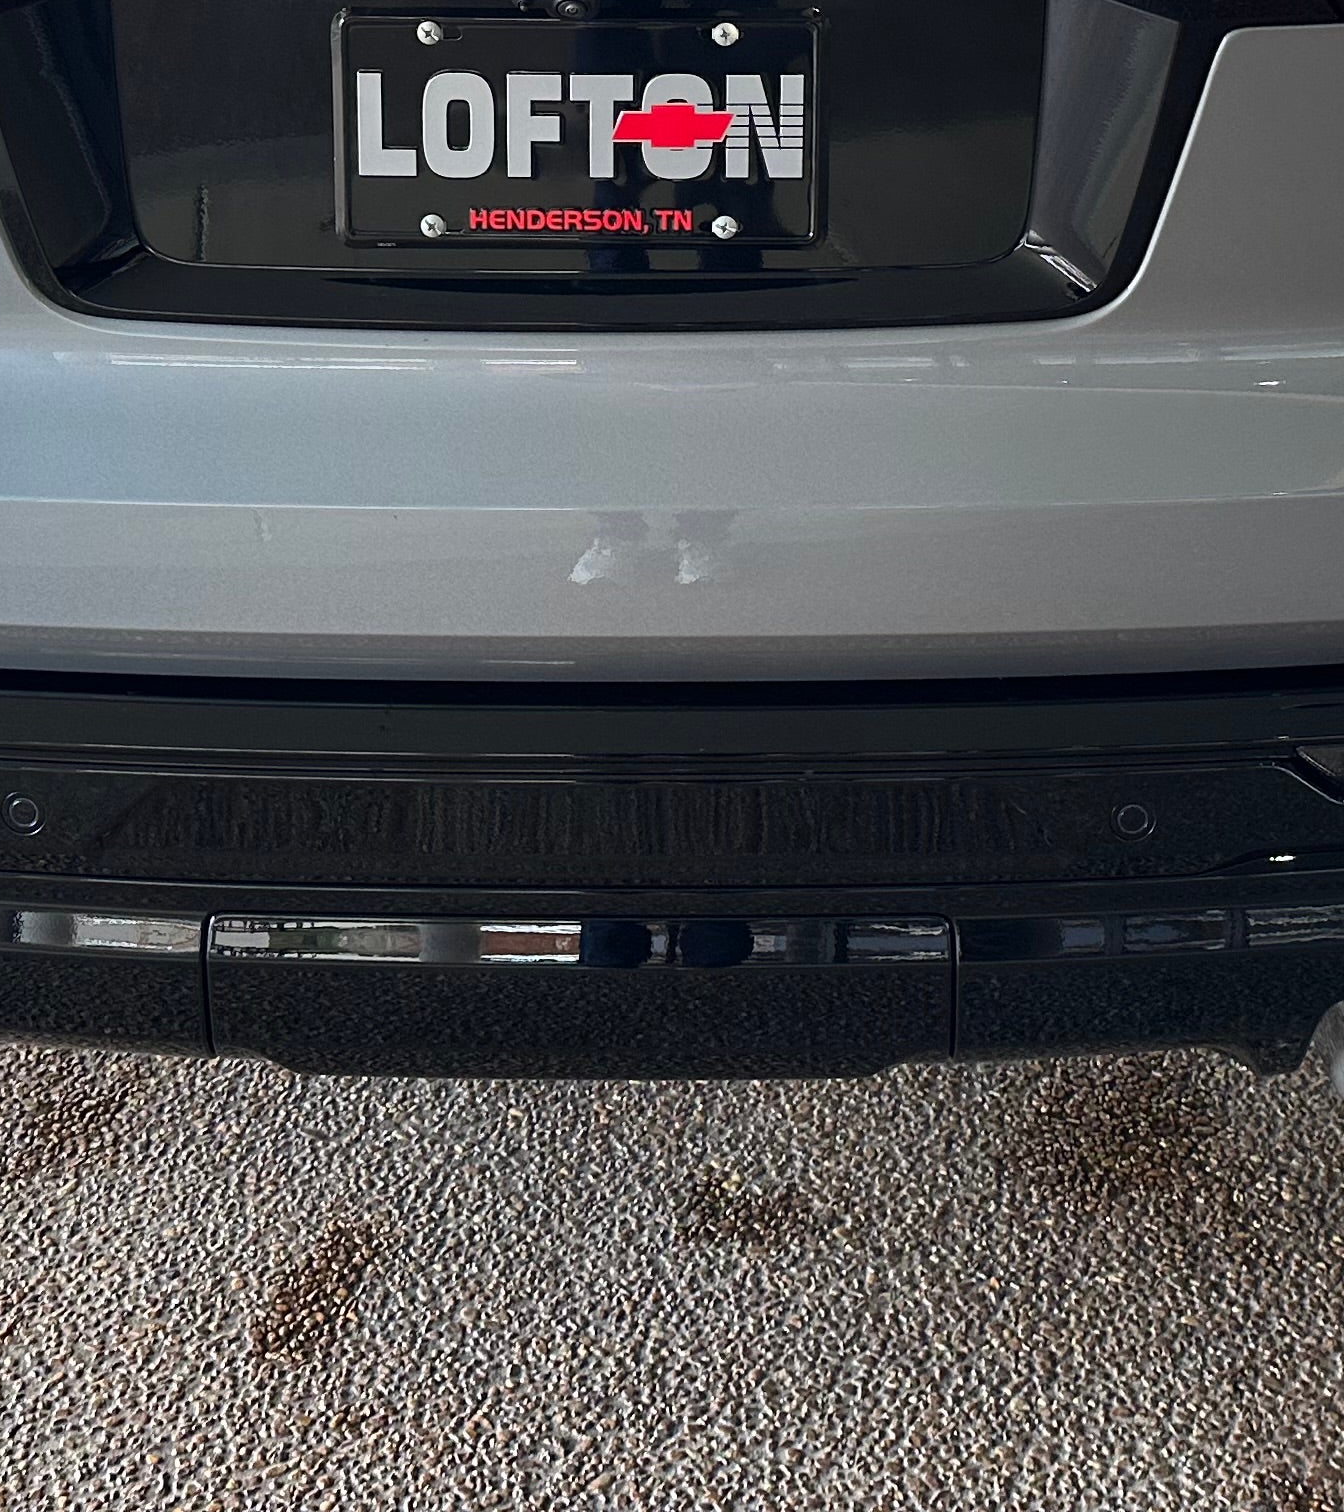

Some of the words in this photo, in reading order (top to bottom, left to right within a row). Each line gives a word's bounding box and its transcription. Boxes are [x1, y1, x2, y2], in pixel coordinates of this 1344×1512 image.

[356, 71, 805, 180] LOFTON
[468, 208, 650, 234] HENDERSON,
[656, 209, 693, 232] TN
